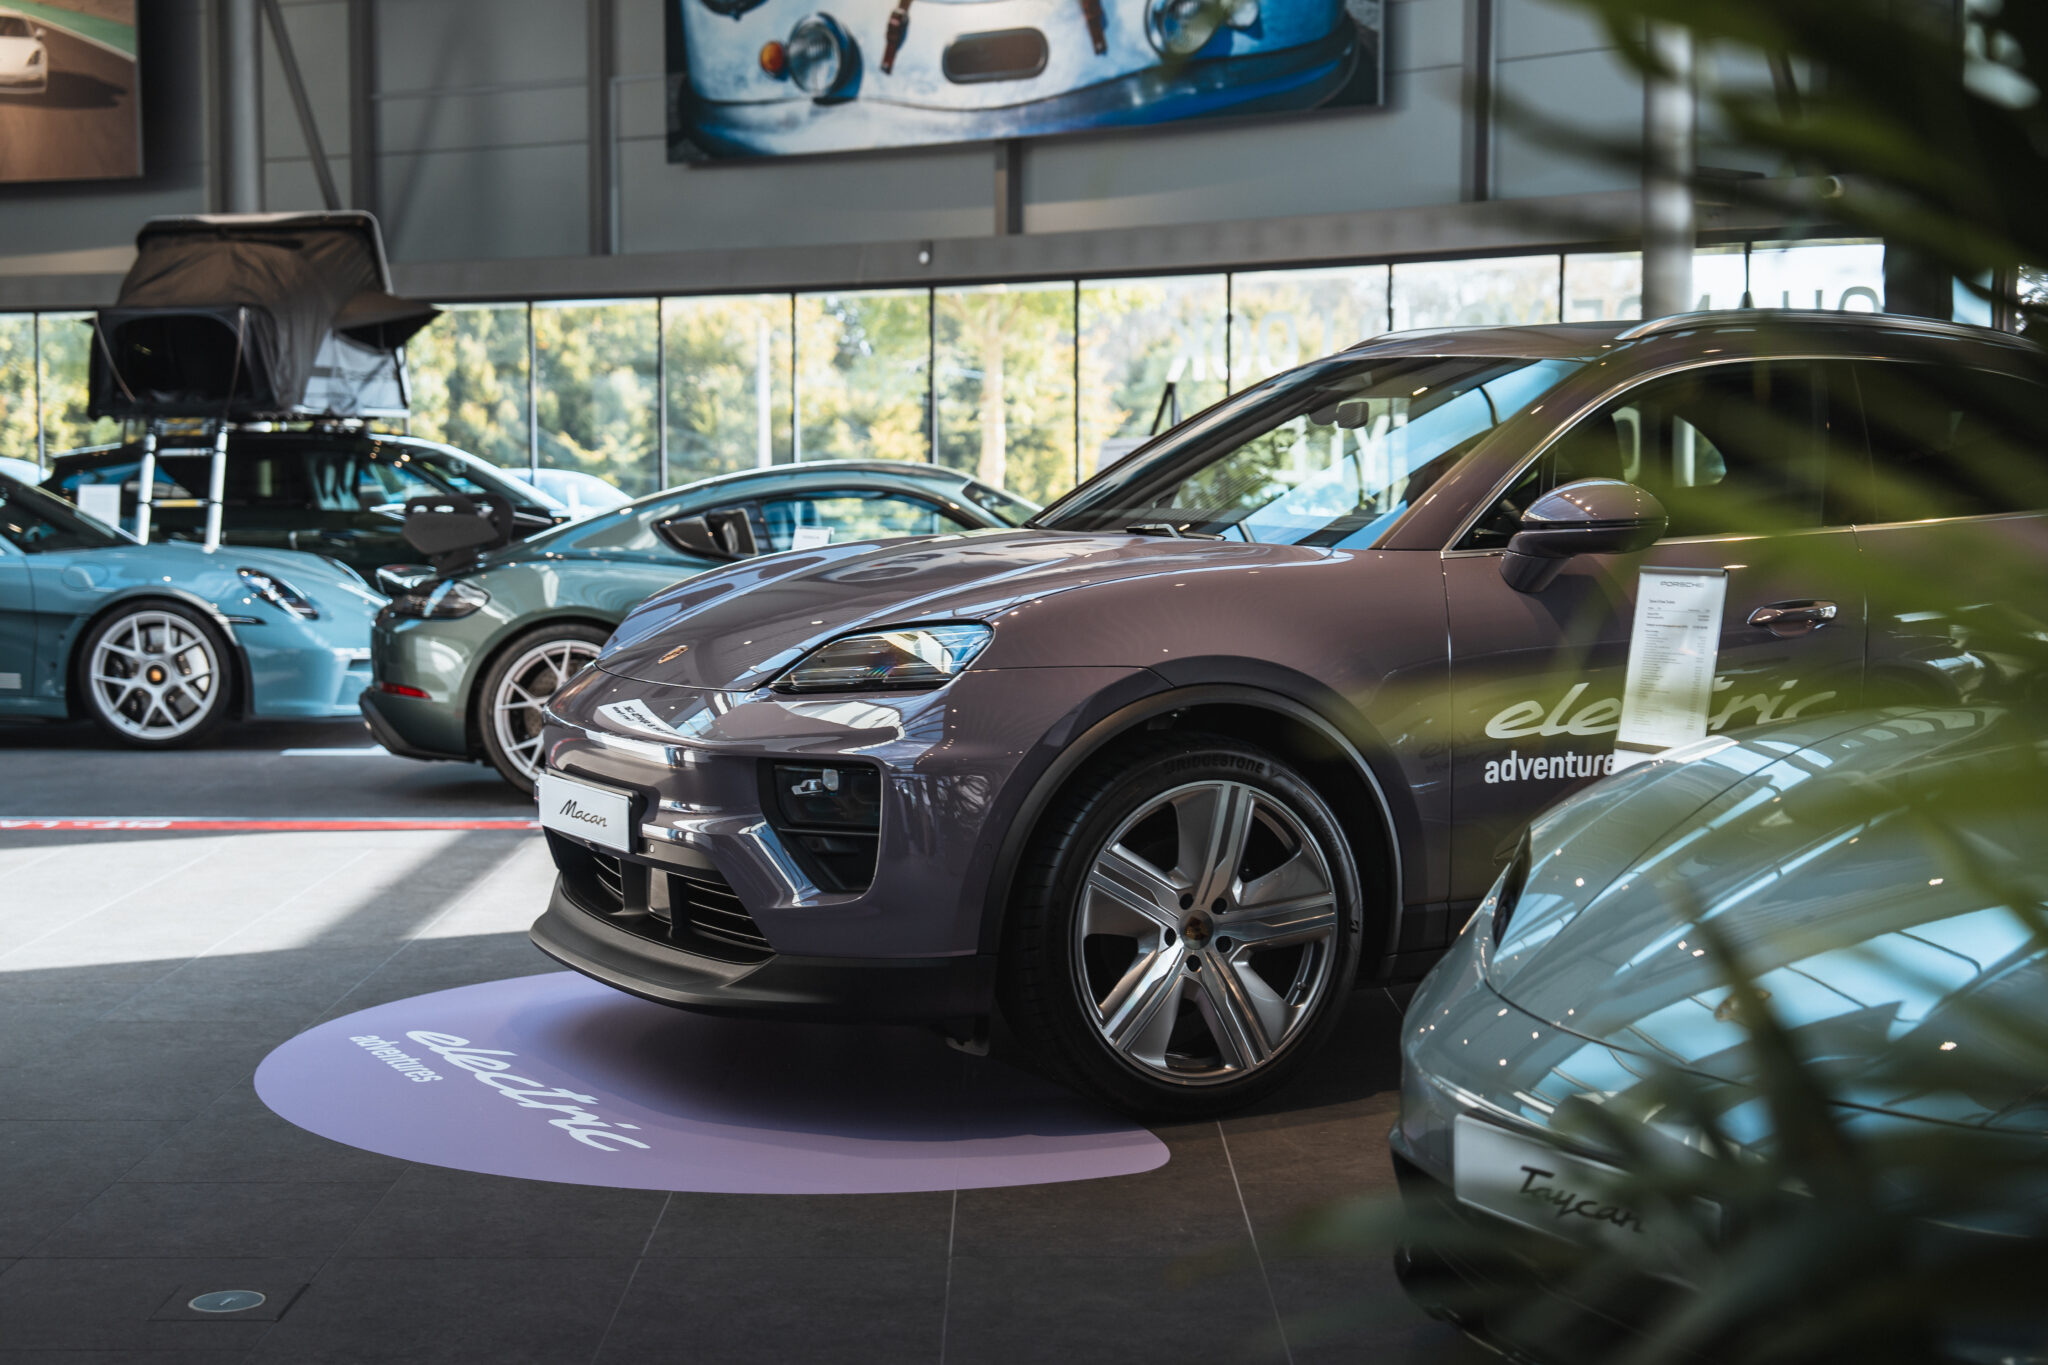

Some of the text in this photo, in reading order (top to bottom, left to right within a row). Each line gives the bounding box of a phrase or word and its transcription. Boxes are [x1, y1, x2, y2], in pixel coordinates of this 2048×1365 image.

[1485, 676, 1837, 739] eleric
[1484, 750, 1615, 784] adventure
[560, 799, 608, 828] Macan
[350, 1035, 443, 1083] adventures
[406, 1031, 650, 1151] electric
[1520, 1165, 1646, 1234] Taycan
